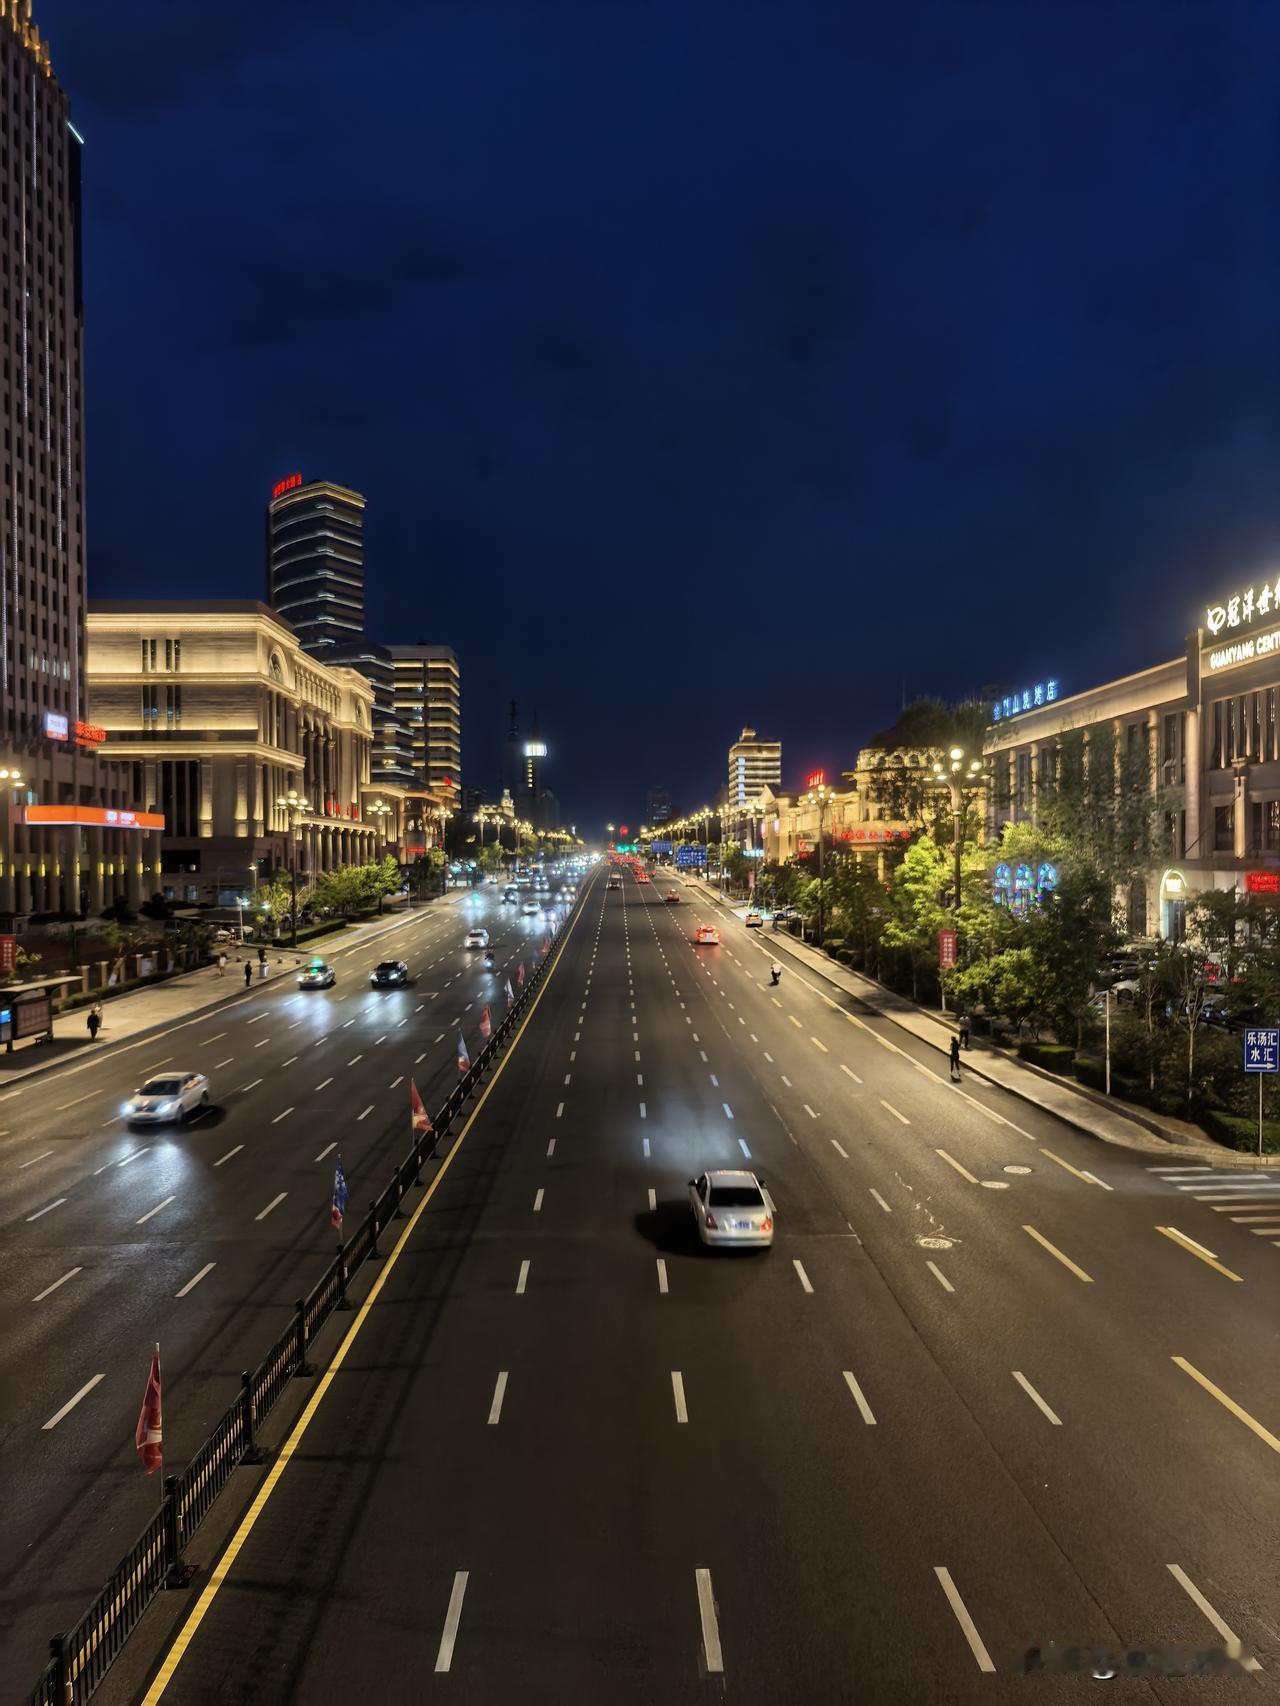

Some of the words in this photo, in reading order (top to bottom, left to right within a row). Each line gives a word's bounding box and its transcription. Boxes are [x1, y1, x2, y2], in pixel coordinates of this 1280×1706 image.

[1210, 640, 1254, 670] GUANYANG
[1256, 631, 1280, 655] CENT
[1247, 1032, 1277, 1046] 乐汤汇
[1250, 1047, 1274, 1062] 水汇
